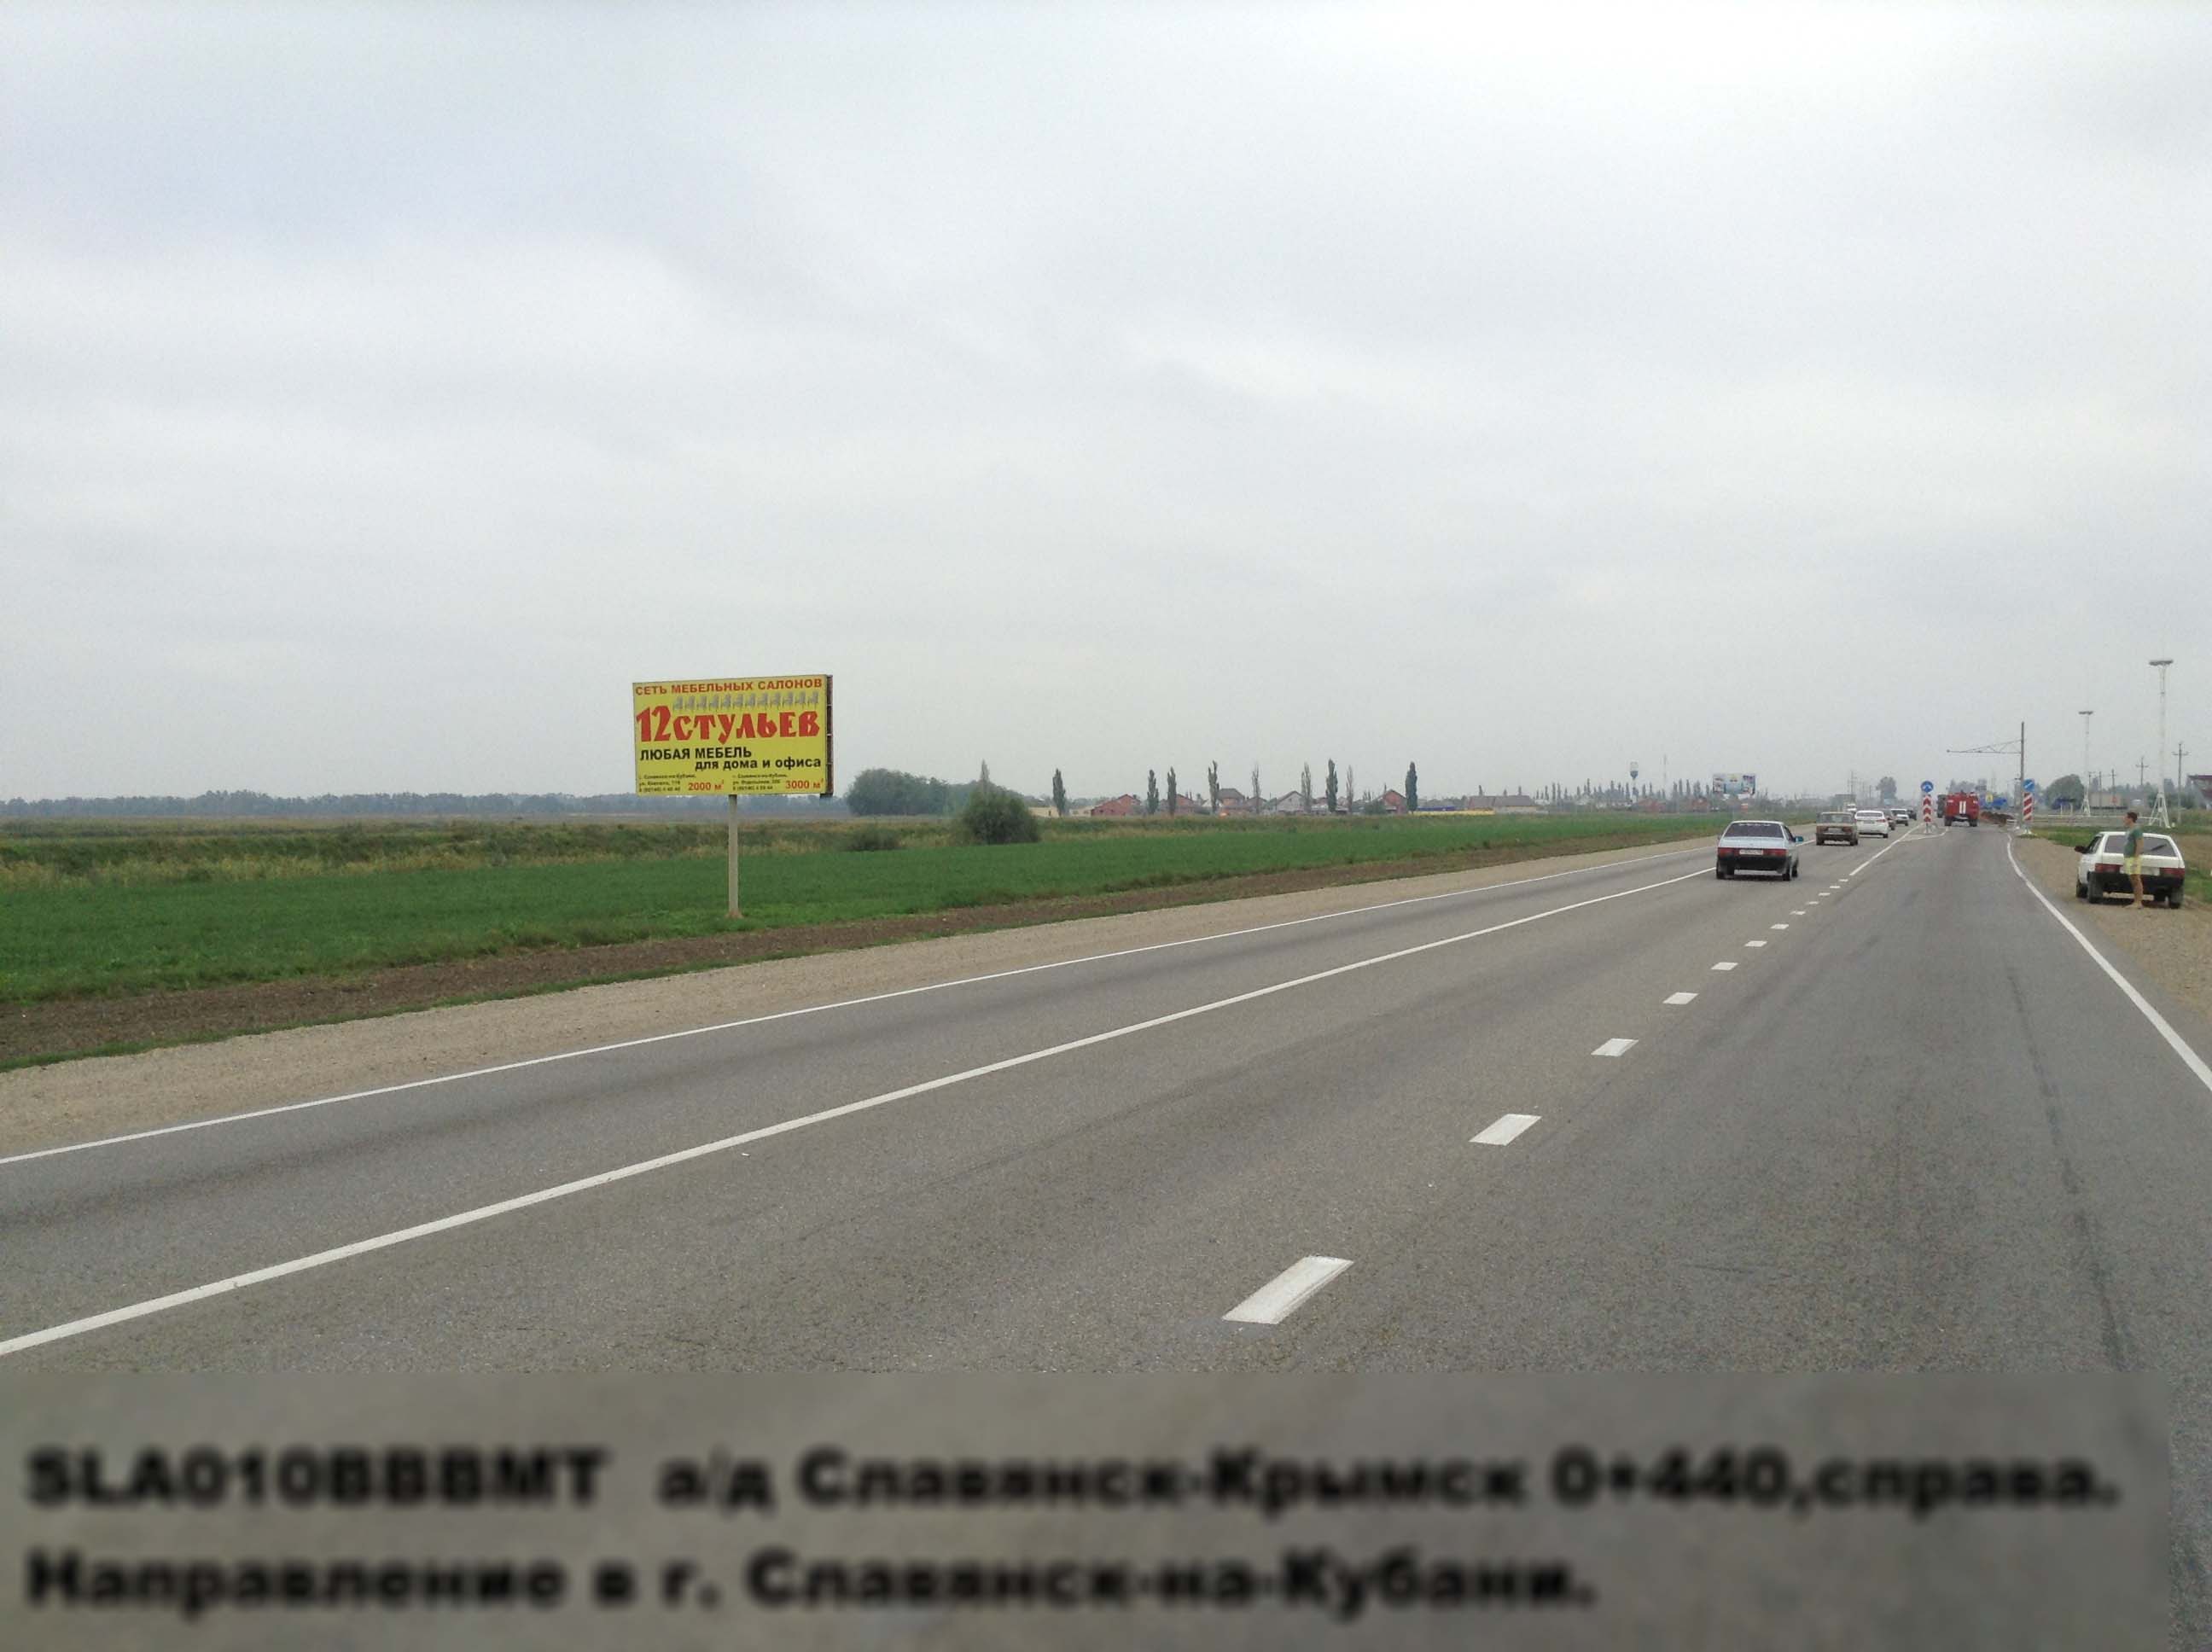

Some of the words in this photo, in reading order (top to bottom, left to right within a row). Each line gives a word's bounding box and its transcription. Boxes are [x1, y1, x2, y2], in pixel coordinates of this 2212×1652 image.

[636, 685, 667, 695] СЕТЬ
[672, 682, 753, 694] МЕБЕЛЬНЫХ
[758, 678, 822, 690] САЛОНОВ
[640, 748, 690, 761] ЛЮБАЯ
[695, 747, 752, 759] МЕБЕЛЬ
[695, 761, 719, 771] для
[723, 759, 758, 771] дома
[763, 759, 771, 768] и
[775, 757, 822, 771] офиса
[688, 782, 712, 791] 2000
[785, 780, 810, 789] 3000
